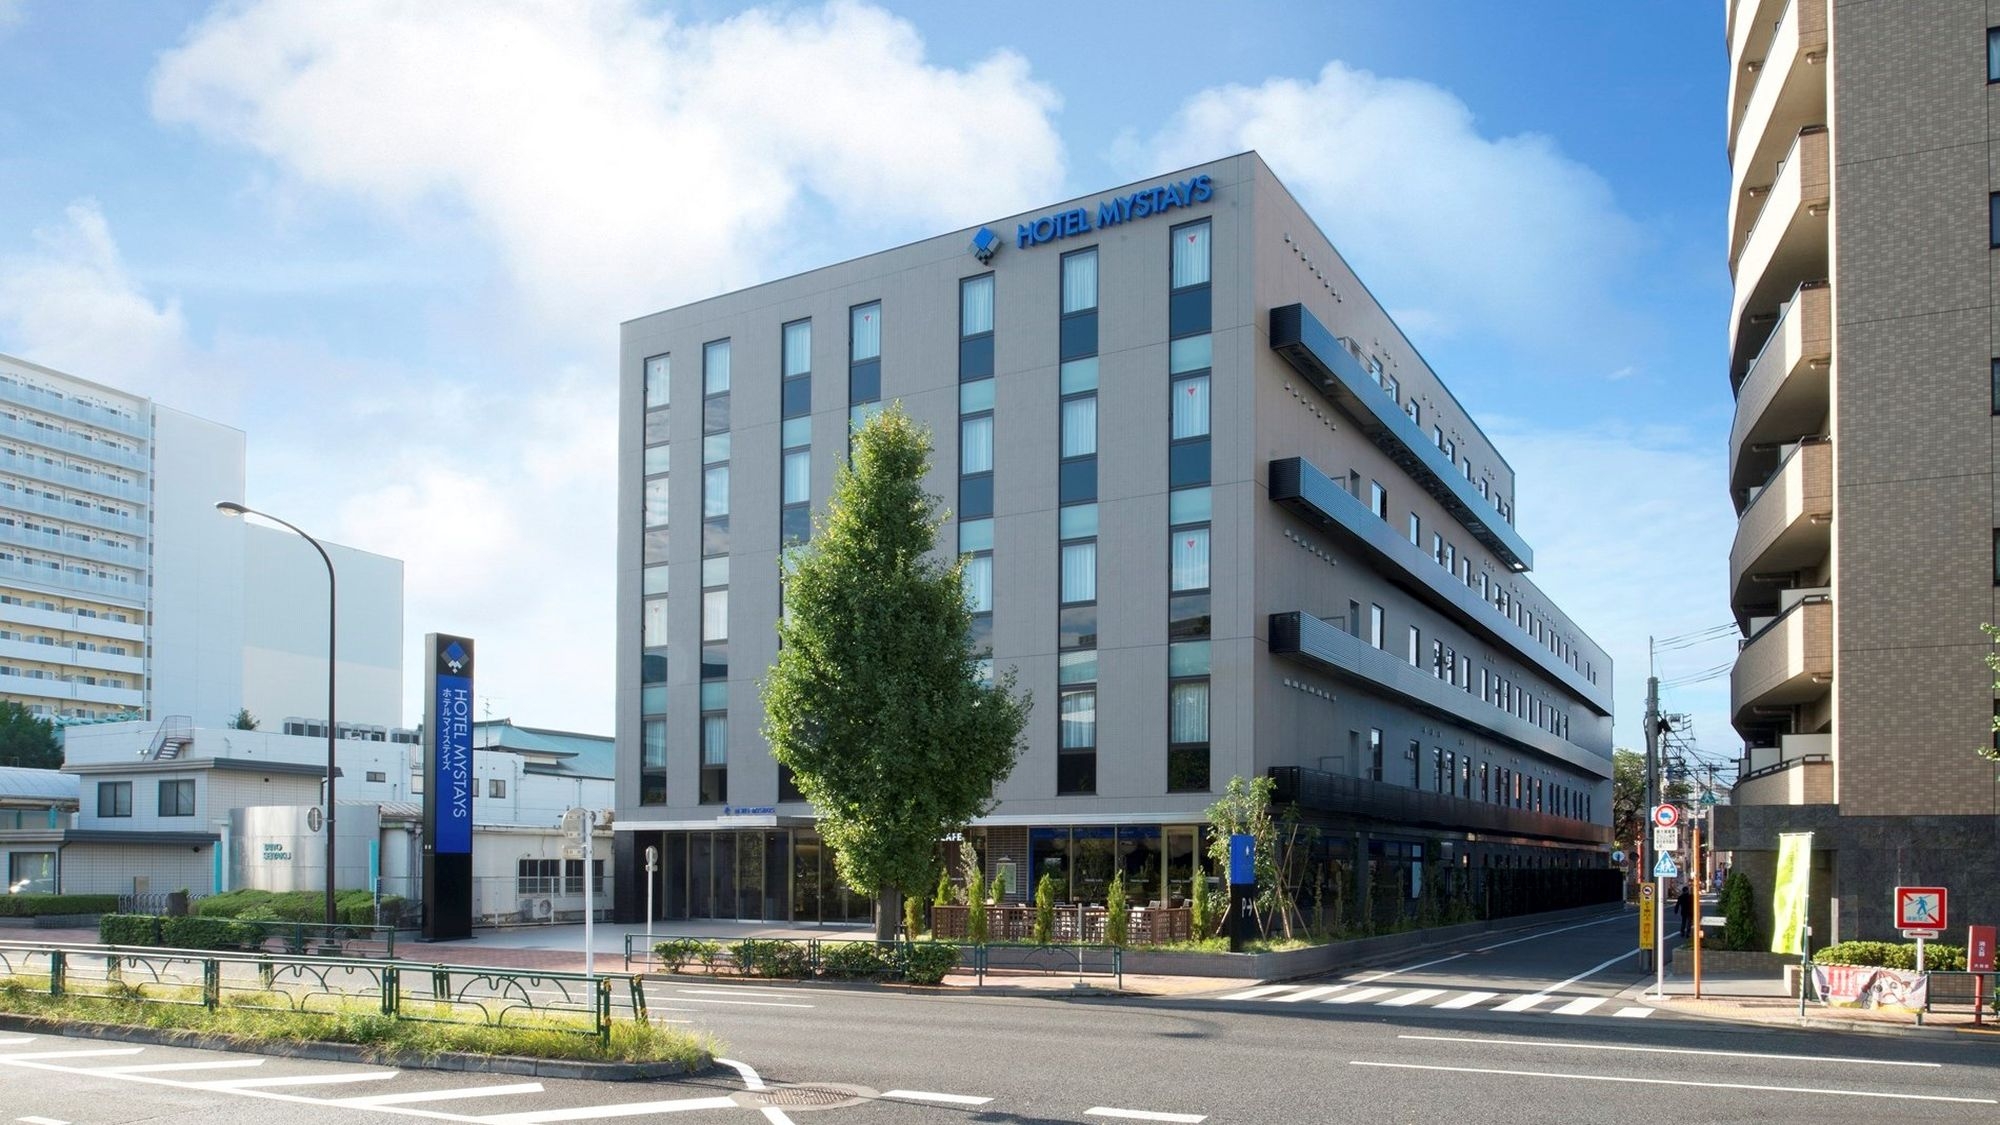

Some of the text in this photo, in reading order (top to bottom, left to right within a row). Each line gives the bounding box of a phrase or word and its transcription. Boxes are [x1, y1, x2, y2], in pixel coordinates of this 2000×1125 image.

[1016, 174, 1214, 249] HOTEL MYSTAYS
[453, 688, 468, 818] HOTEL MYSTAYS
[940, 832, 962, 842] AFE
